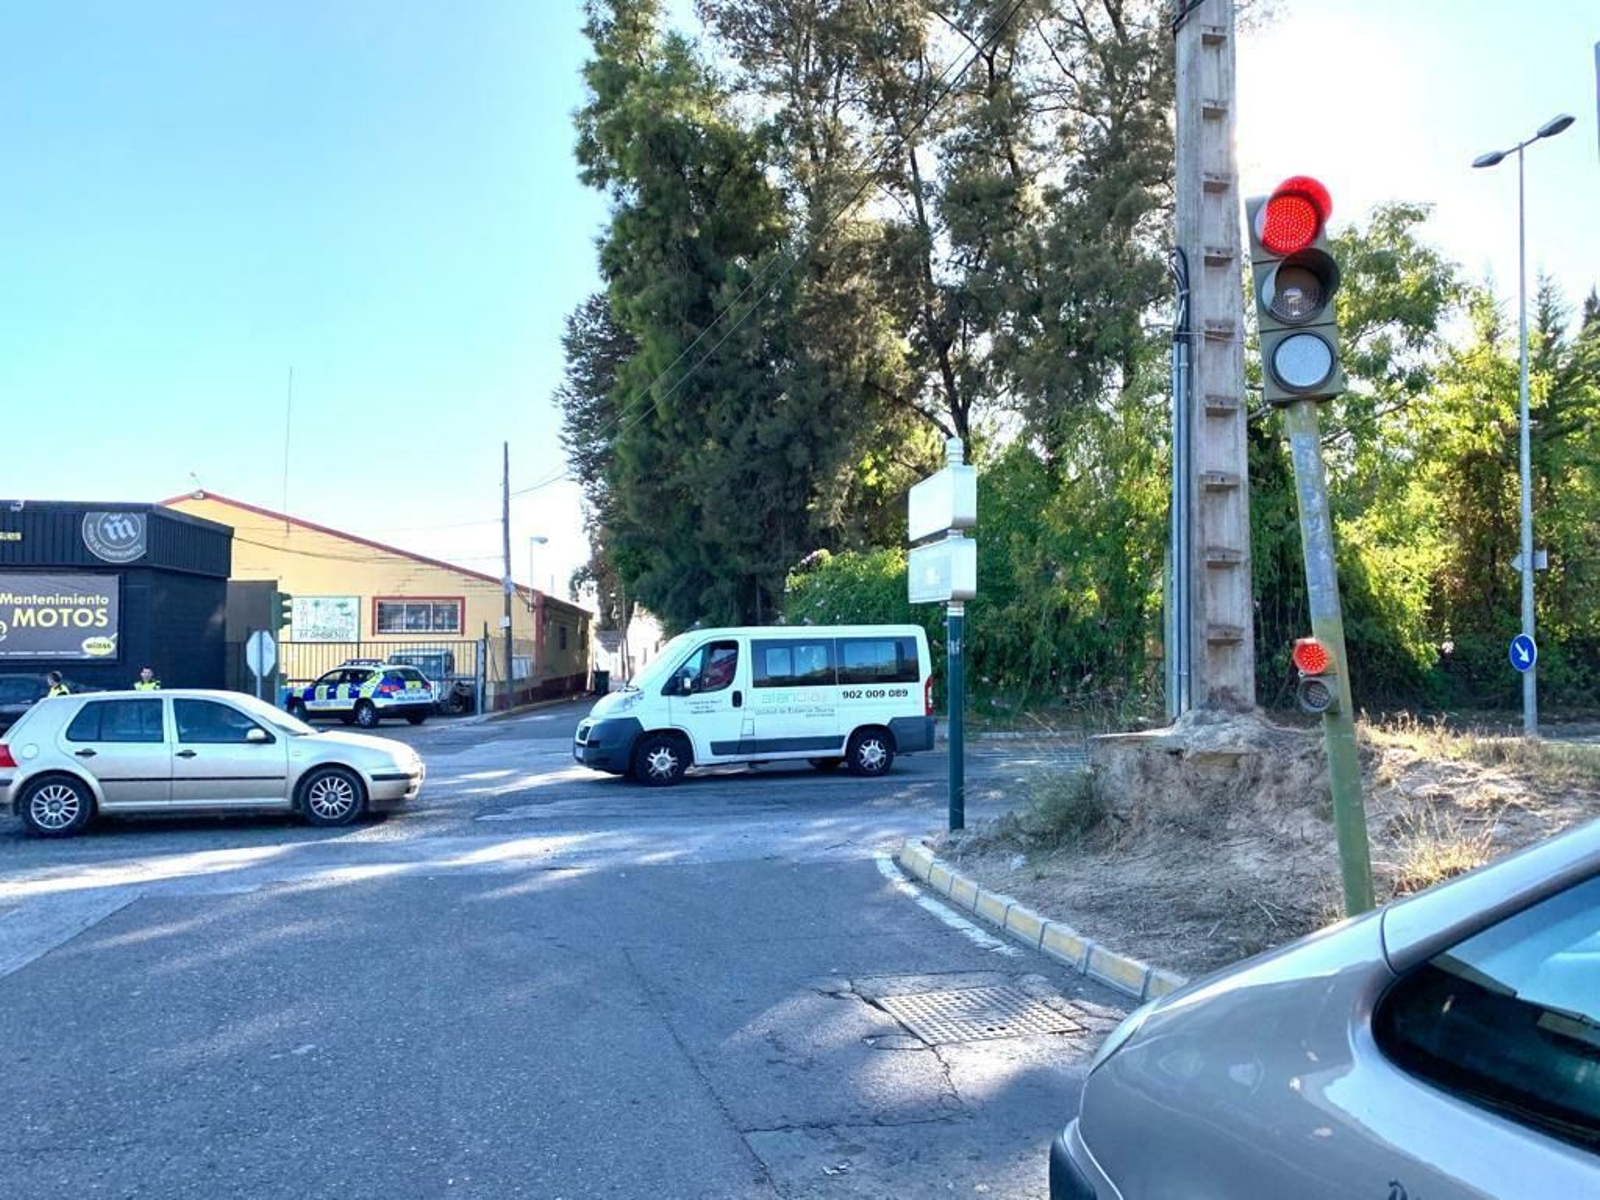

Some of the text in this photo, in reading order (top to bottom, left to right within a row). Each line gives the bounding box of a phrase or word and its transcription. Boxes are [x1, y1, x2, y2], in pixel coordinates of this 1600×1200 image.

[0, 593, 109, 605] Mantenimiento
[12, 608, 108, 627] MOTOS
[842, 688, 909, 699] 902 009 089
